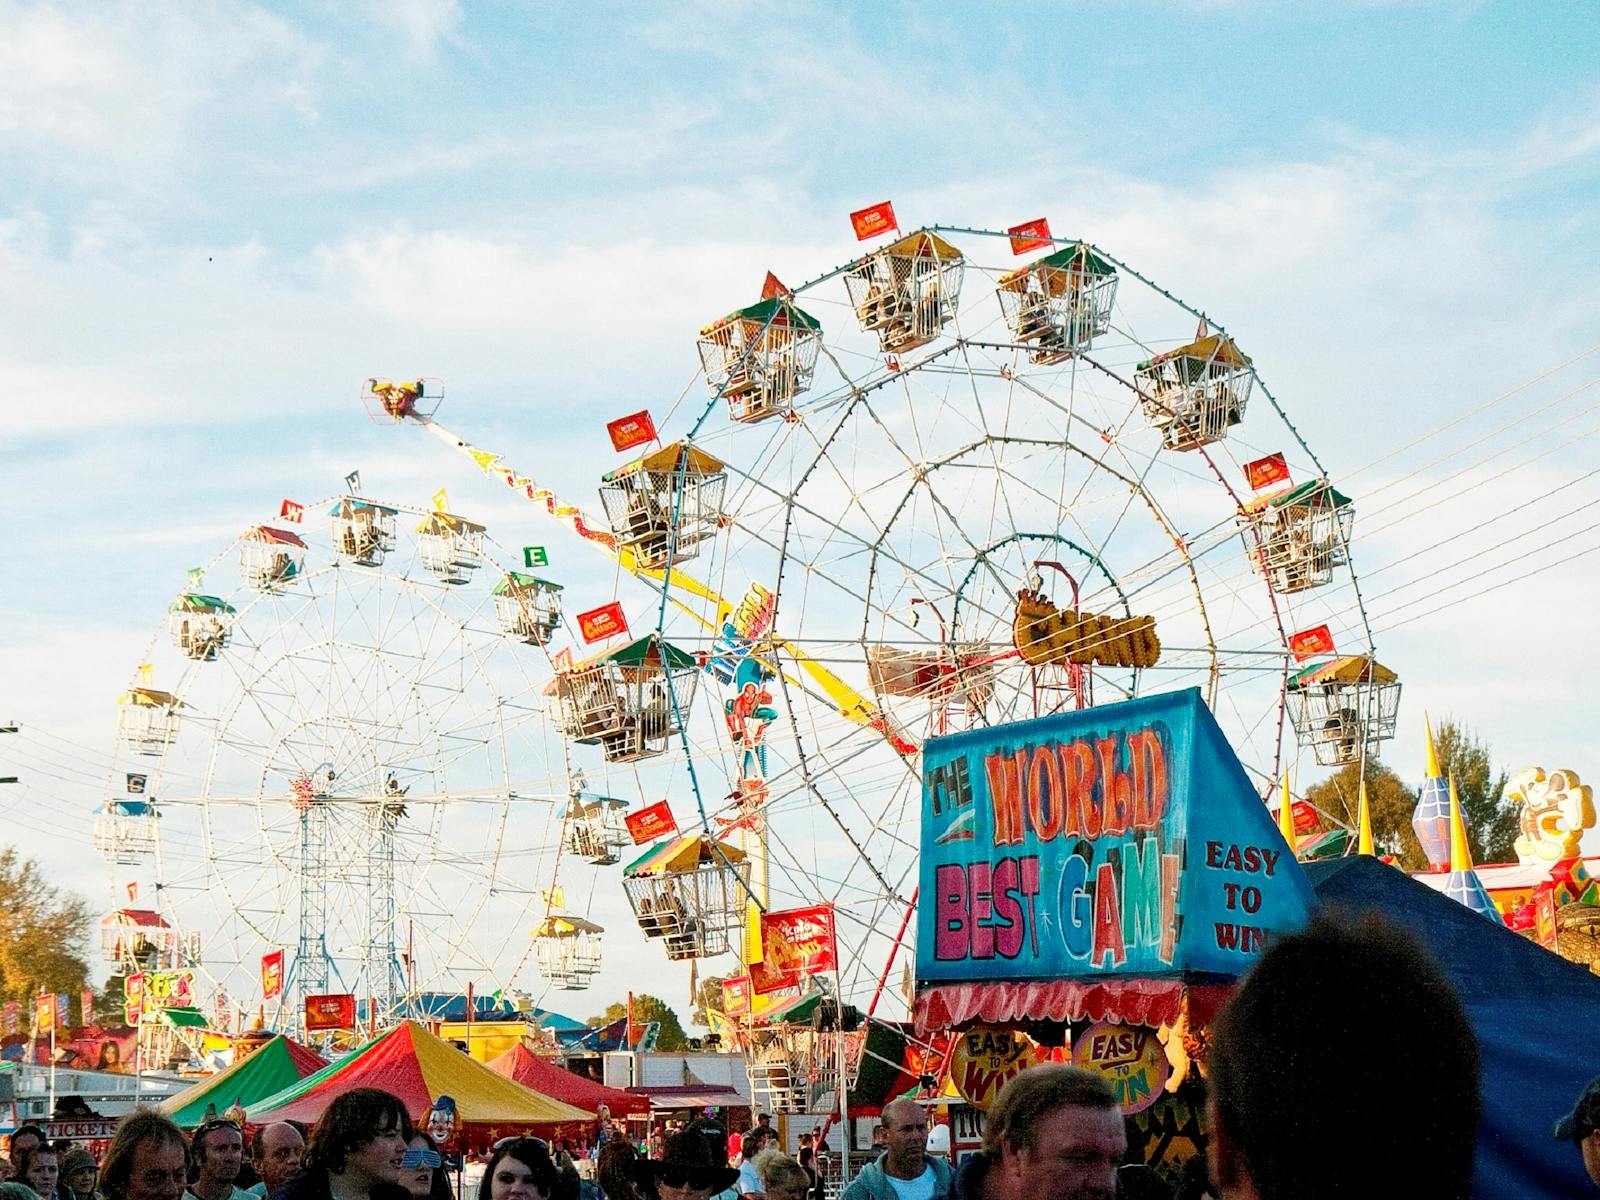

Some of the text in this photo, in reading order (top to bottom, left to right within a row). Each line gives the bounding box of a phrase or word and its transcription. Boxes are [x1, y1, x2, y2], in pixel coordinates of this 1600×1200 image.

[286, 503, 301, 521] W
[530, 549, 546, 566] E
[927, 727, 1169, 848] THE WORLD
[1205, 841, 1280, 877] EASY
[935, 837, 1182, 968] BEST GAME
[1223, 883, 1262, 914] TO
[966, 1031, 1027, 1062] EASY
[1091, 1032, 1146, 1066] EASY
[989, 1057, 1001, 1068] TO
[1115, 1064, 1130, 1077] TO
[1108, 1067, 1151, 1104] IN
